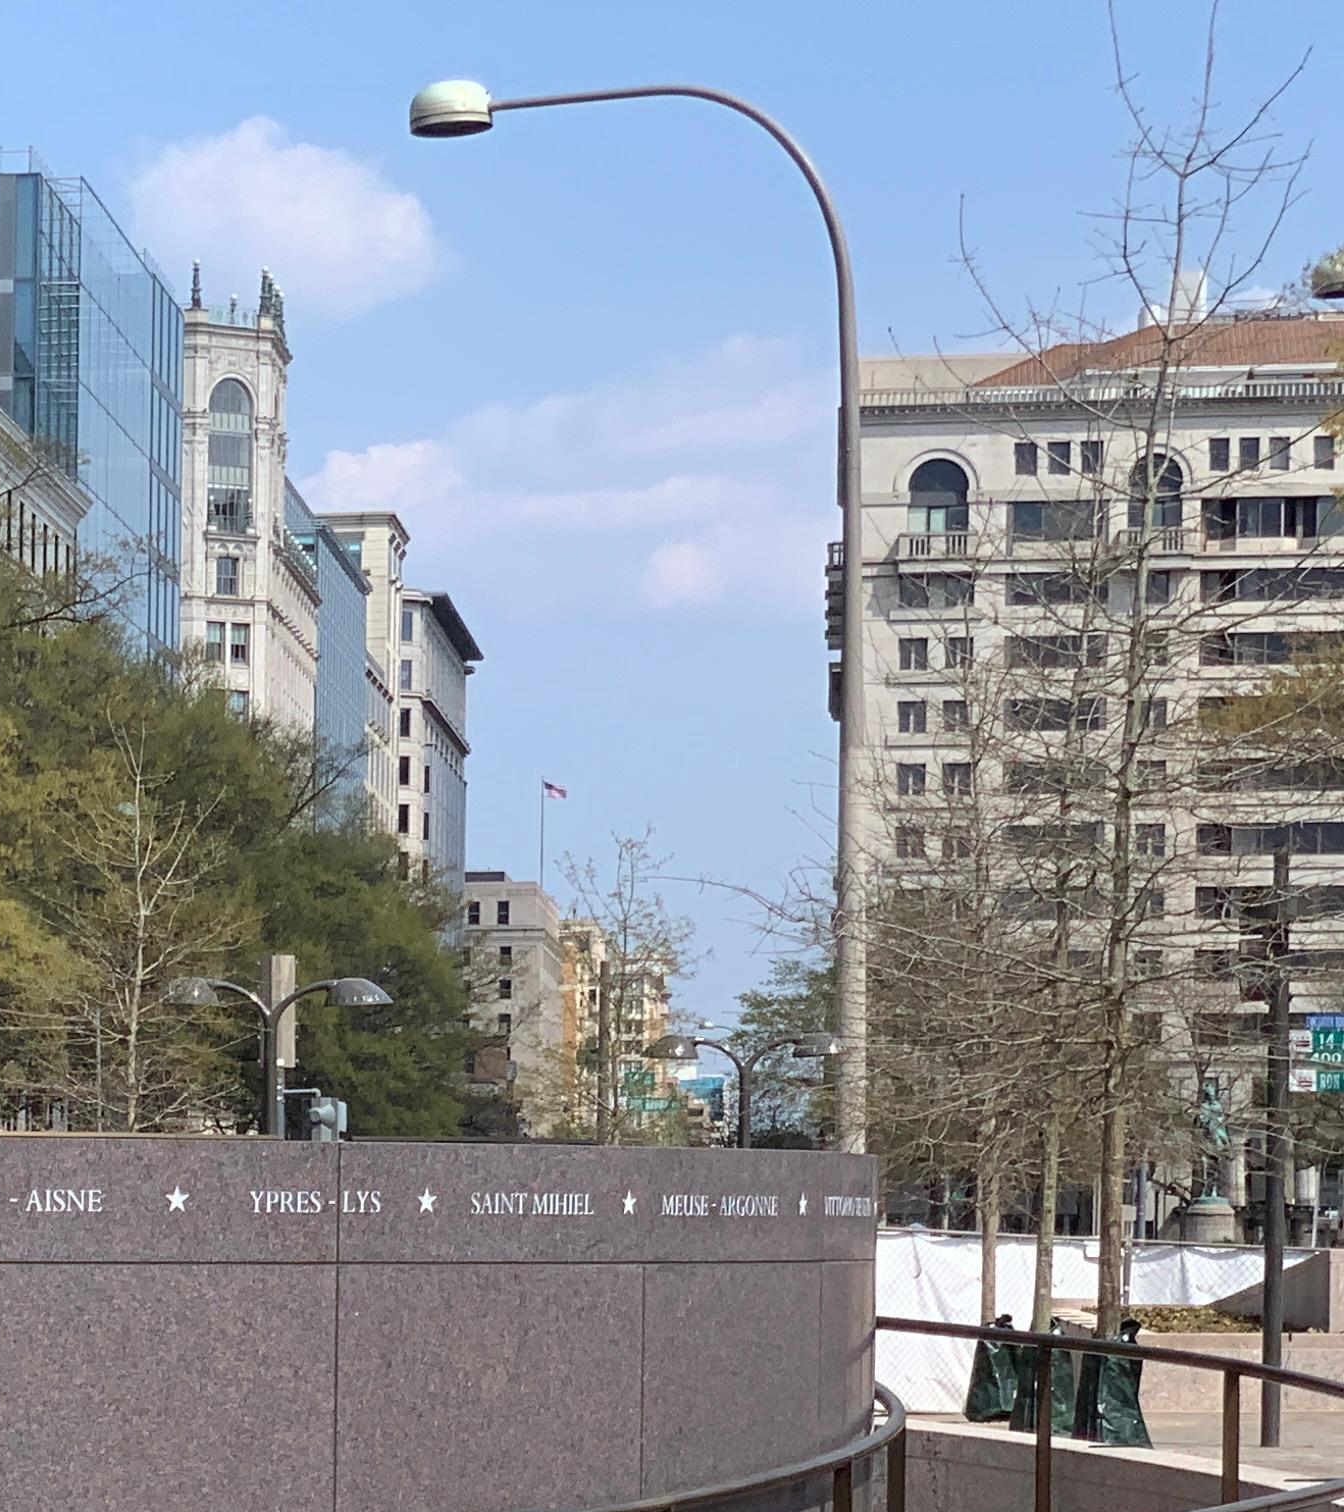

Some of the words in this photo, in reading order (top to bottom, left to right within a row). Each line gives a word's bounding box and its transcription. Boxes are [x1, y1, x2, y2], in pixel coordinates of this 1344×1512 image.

[26, 1189, 103, 1213] AISNE
[250, 1191, 322, 1214] YPRES
[343, 1191, 382, 1214] LYS
[470, 1192, 528, 1216] SAINT
[532, 1193, 595, 1216] MIHIEL
[660, 1195, 709, 1217] MEUSE
[719, 1195, 778, 1217] ARGONNE
